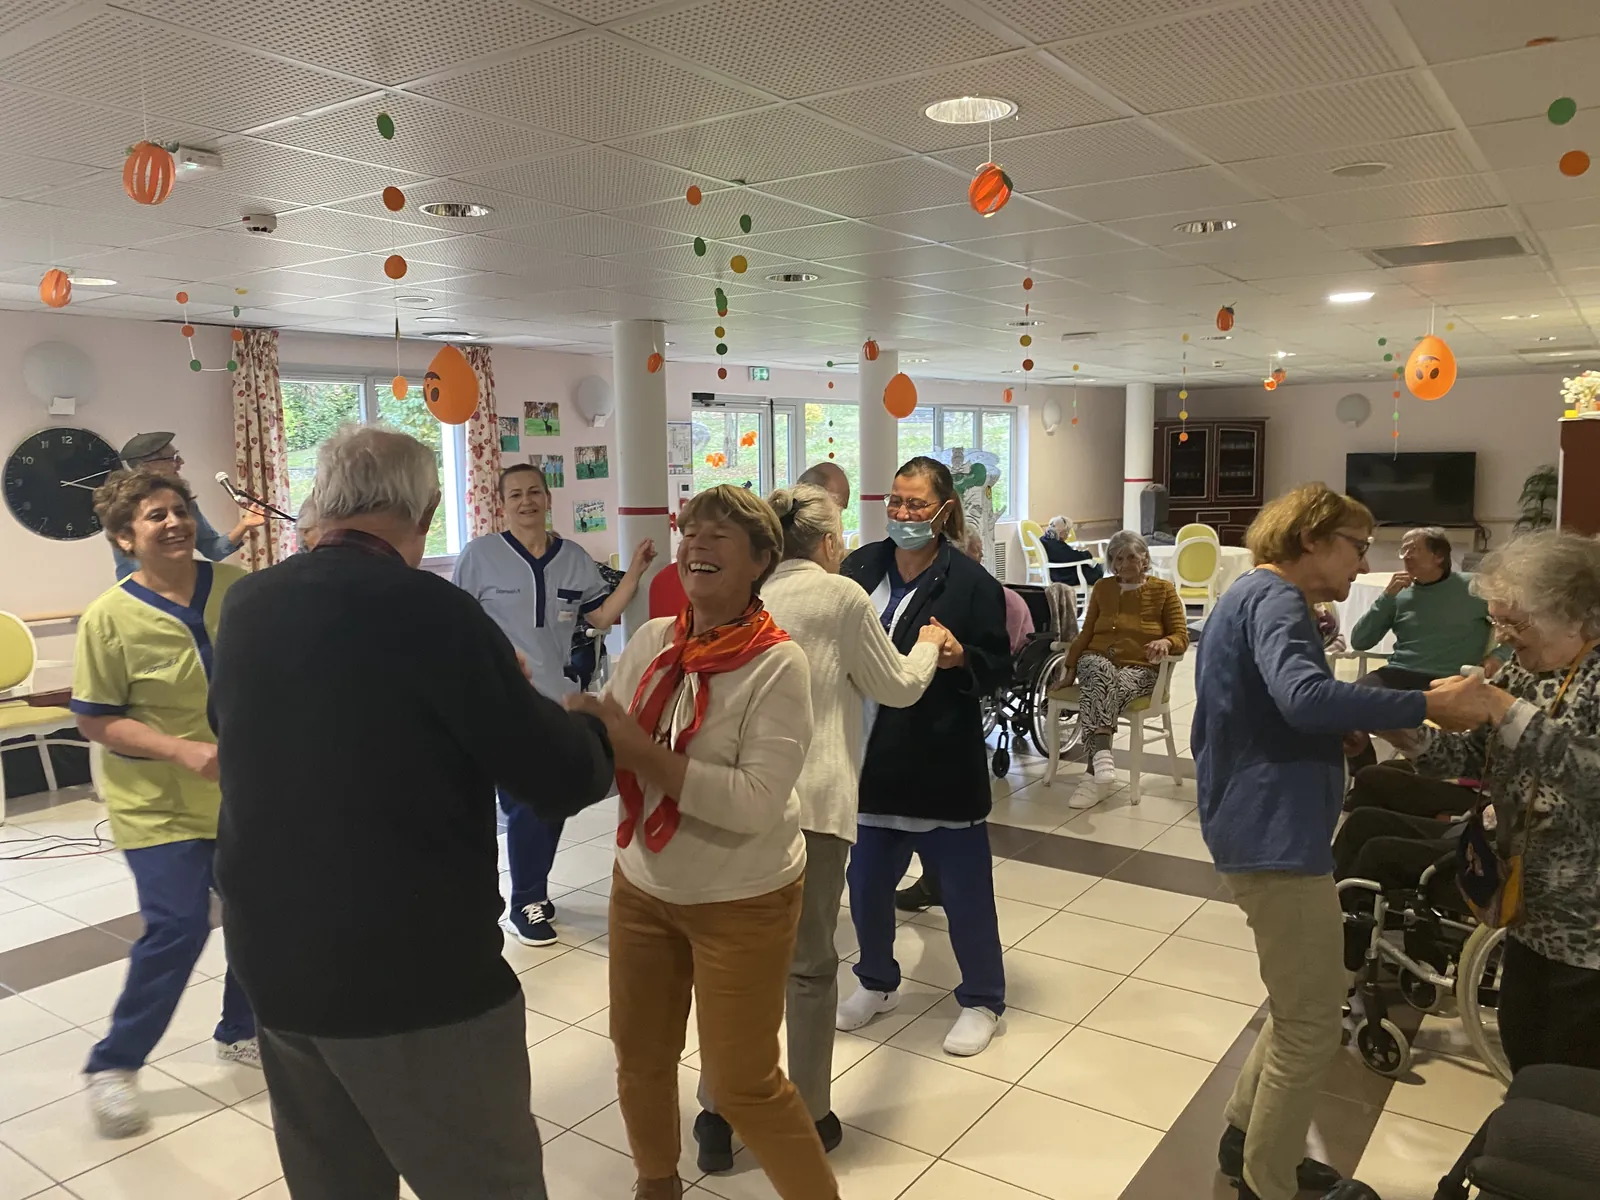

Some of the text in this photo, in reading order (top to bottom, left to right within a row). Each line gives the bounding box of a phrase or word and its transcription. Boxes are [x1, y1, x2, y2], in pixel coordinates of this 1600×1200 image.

[61, 435, 73, 444] 12
[41, 440, 49, 449] 11
[21, 456, 34, 465] 10
[15, 478, 22, 486] 9
[41, 517, 48, 525] 7
[66, 523, 73, 531] 6
